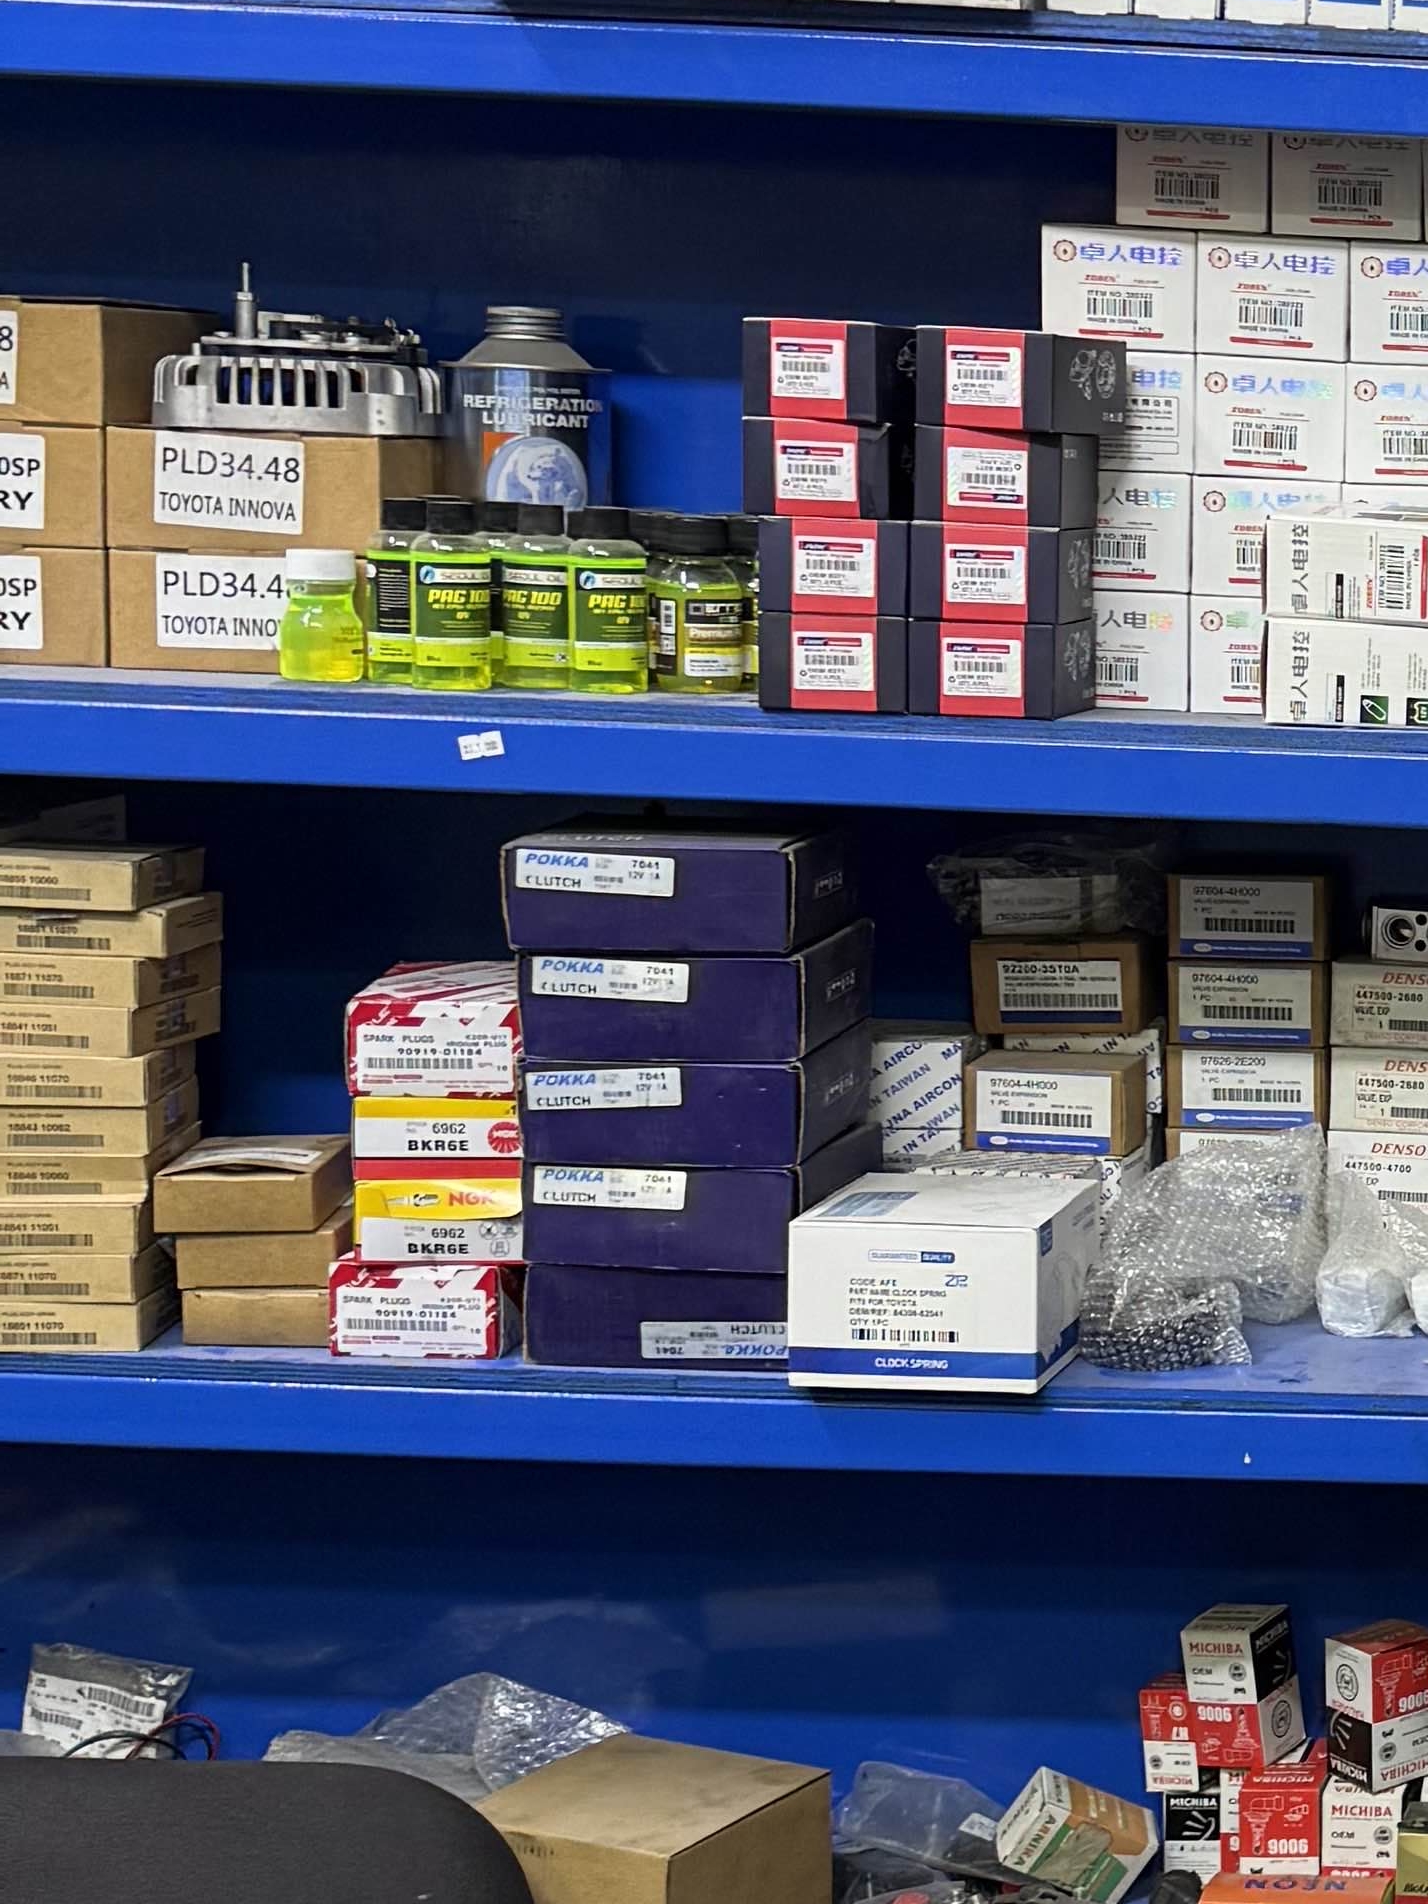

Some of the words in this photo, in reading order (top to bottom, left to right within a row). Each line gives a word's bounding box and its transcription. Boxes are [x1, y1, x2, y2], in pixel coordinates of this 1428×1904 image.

[1080, 243, 1182, 266] 卓人电控
[1234, 251, 1336, 276] 卓人电控
[463, 394, 604, 414] REFRIGERATION
[482, 411, 589, 429] LUBRICANT
[161, 446, 300, 484] PLD34.48
[159, 490, 224, 517] TOYOTA
[228, 494, 297, 522] INNOVA
[163, 570, 292, 600] PLD34.4
[428, 589, 466, 604] PAG
[530, 591, 562, 605] 100
[588, 594, 627, 609] PAG
[162, 614, 229, 636] TOYOTA
[233, 616, 281, 638] INNO
[524, 852, 589, 869] POKKA
[631, 859, 660, 871] 7041
[525, 875, 581, 889] CLUTCH
[541, 959, 605, 975] POKKA
[646, 965, 675, 976] 7041
[541, 981, 598, 995] CLUTCH
[363, 1034, 395, 1043] SPARK
[402, 1034, 435, 1044] PLUGS
[398, 1047, 482, 1057] 90919-01184
[533, 1072, 597, 1086] POKKA
[638, 1071, 666, 1081] 7041
[912, 1073, 963, 1111] AIRCON
[536, 1096, 591, 1107] CLUTCH
[432, 1122, 466, 1135] 6962
[407, 1139, 469, 1152] BKR6E
[1371, 1142, 1427, 1157] DENSO
[542, 1168, 604, 1182] POKKA
[448, 1190, 494, 1206] NGK
[543, 1190, 596, 1203] CLUTCH
[431, 1227, 466, 1239] 6962
[407, 1243, 469, 1255] BKR6E
[343, 1296, 373, 1305] SPARK
[380, 1296, 411, 1306] PLUGS
[730, 1324, 786, 1336] CLUTCH
[724, 1344, 788, 1357] POKKA
[874, 1357, 909, 1368] CLOCK
[909, 1359, 949, 1370] SPRING
[1188, 1641, 1244, 1655] MICHIBA
[1197, 1706, 1233, 1723] 9006
[1170, 1797, 1218, 1808] MICHIBA
[1331, 1804, 1393, 1817] MICHIBA
[1267, 1838, 1309, 1855] 9006
